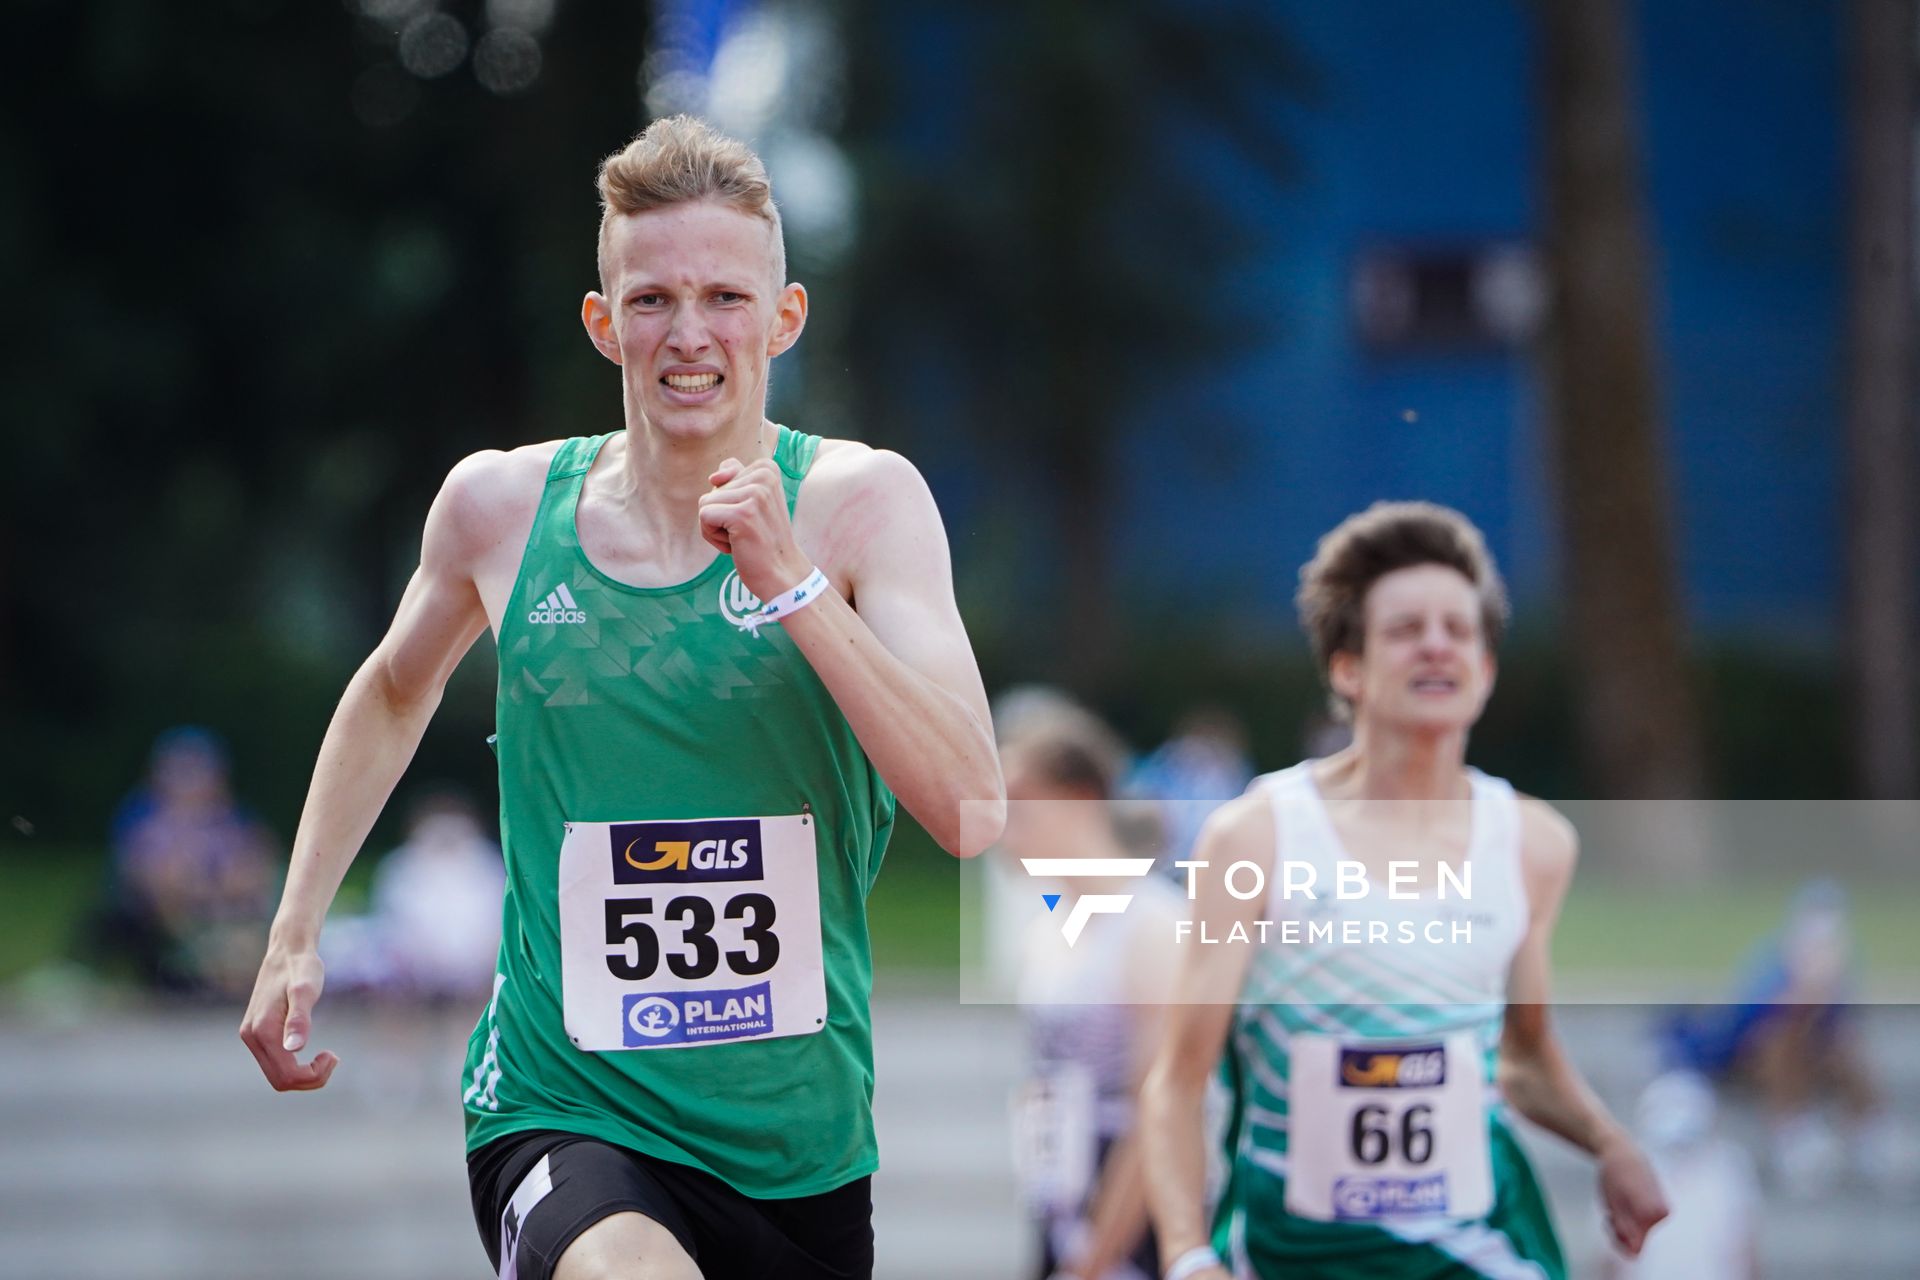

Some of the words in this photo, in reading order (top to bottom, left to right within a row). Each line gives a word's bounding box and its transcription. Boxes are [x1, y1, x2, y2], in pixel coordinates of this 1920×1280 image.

[528, 608, 586, 624] adidas
[691, 838, 748, 870] GLS
[604, 892, 780, 981] 533
[684, 993, 766, 1024] PLAN
[686, 1020, 767, 1036] INTERNATIONAL
[1350, 1104, 1435, 1165] 66
